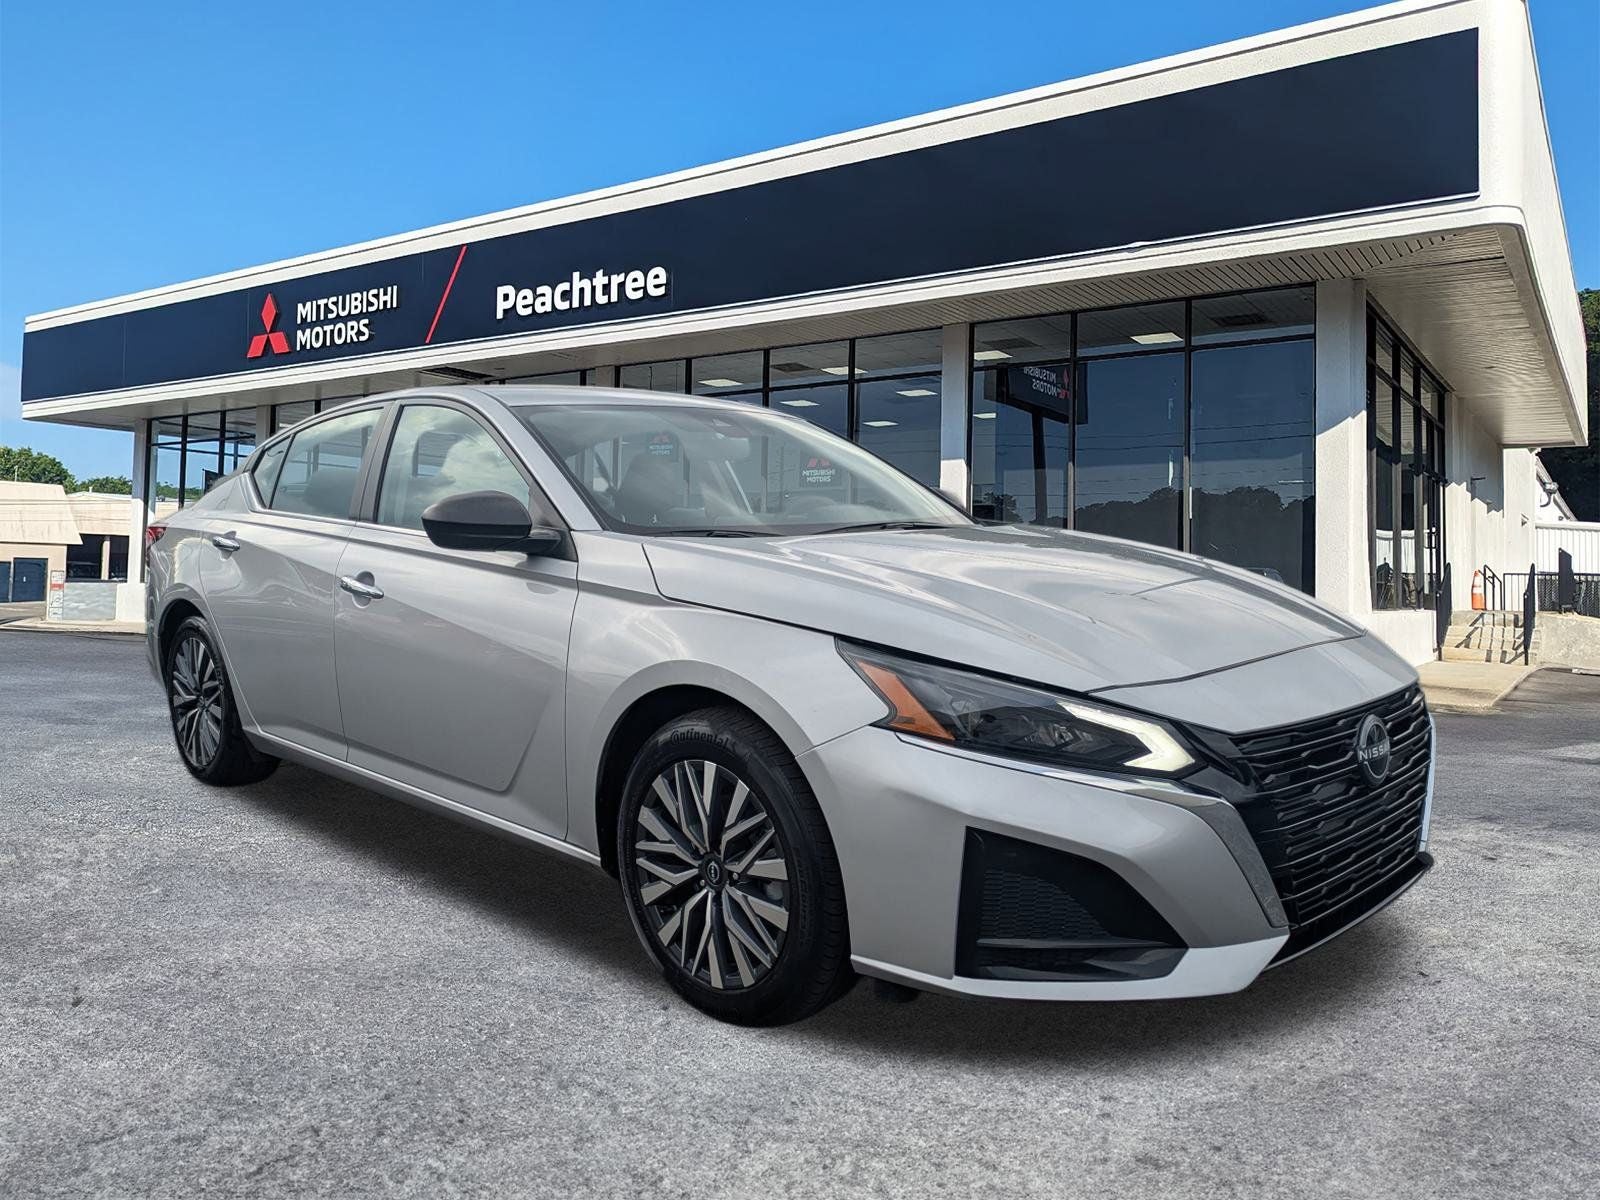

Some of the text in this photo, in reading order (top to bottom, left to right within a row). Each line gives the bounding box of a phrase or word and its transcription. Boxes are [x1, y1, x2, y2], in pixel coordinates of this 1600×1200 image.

[296, 285, 398, 324] MITSUBISHI
[496, 266, 667, 319] Peachtree
[296, 318, 370, 351] MOTORS
[671, 728, 730, 748] Continental
[1359, 744, 1386, 760] NISS
